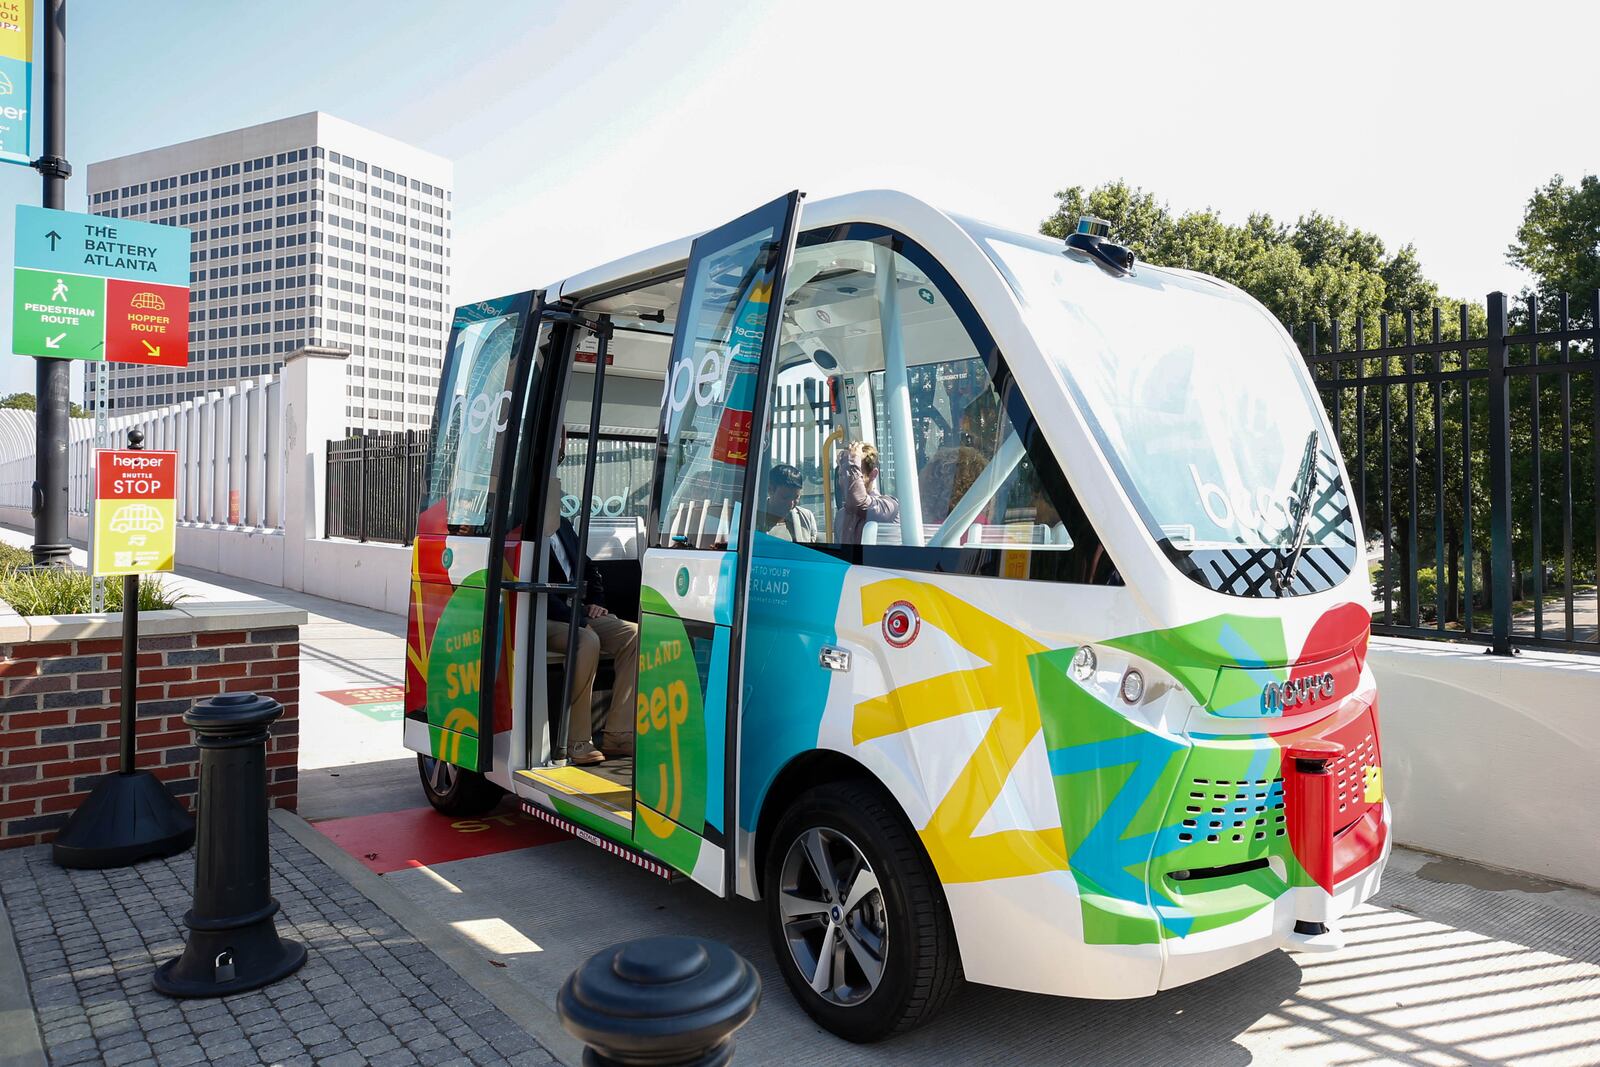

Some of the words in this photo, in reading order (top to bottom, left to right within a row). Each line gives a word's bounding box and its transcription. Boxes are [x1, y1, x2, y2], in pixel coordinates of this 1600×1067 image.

[0, 2, 19, 12] LK
[85, 224, 118, 240] THE
[85, 239, 157, 258] BATTERY
[84, 254, 157, 272] ATLANTA
[25, 302, 95, 318] PEDESTRIAN
[41, 314, 80, 326] ROUTE
[127, 313, 170, 325] HOPPER
[131, 323, 166, 334] ROUTE
[660, 342, 741, 434] per
[113, 480, 161, 494] STOP
[759, 566, 767, 575] TO
[769, 567, 782, 577] YOU
[782, 568, 791, 577] BY
